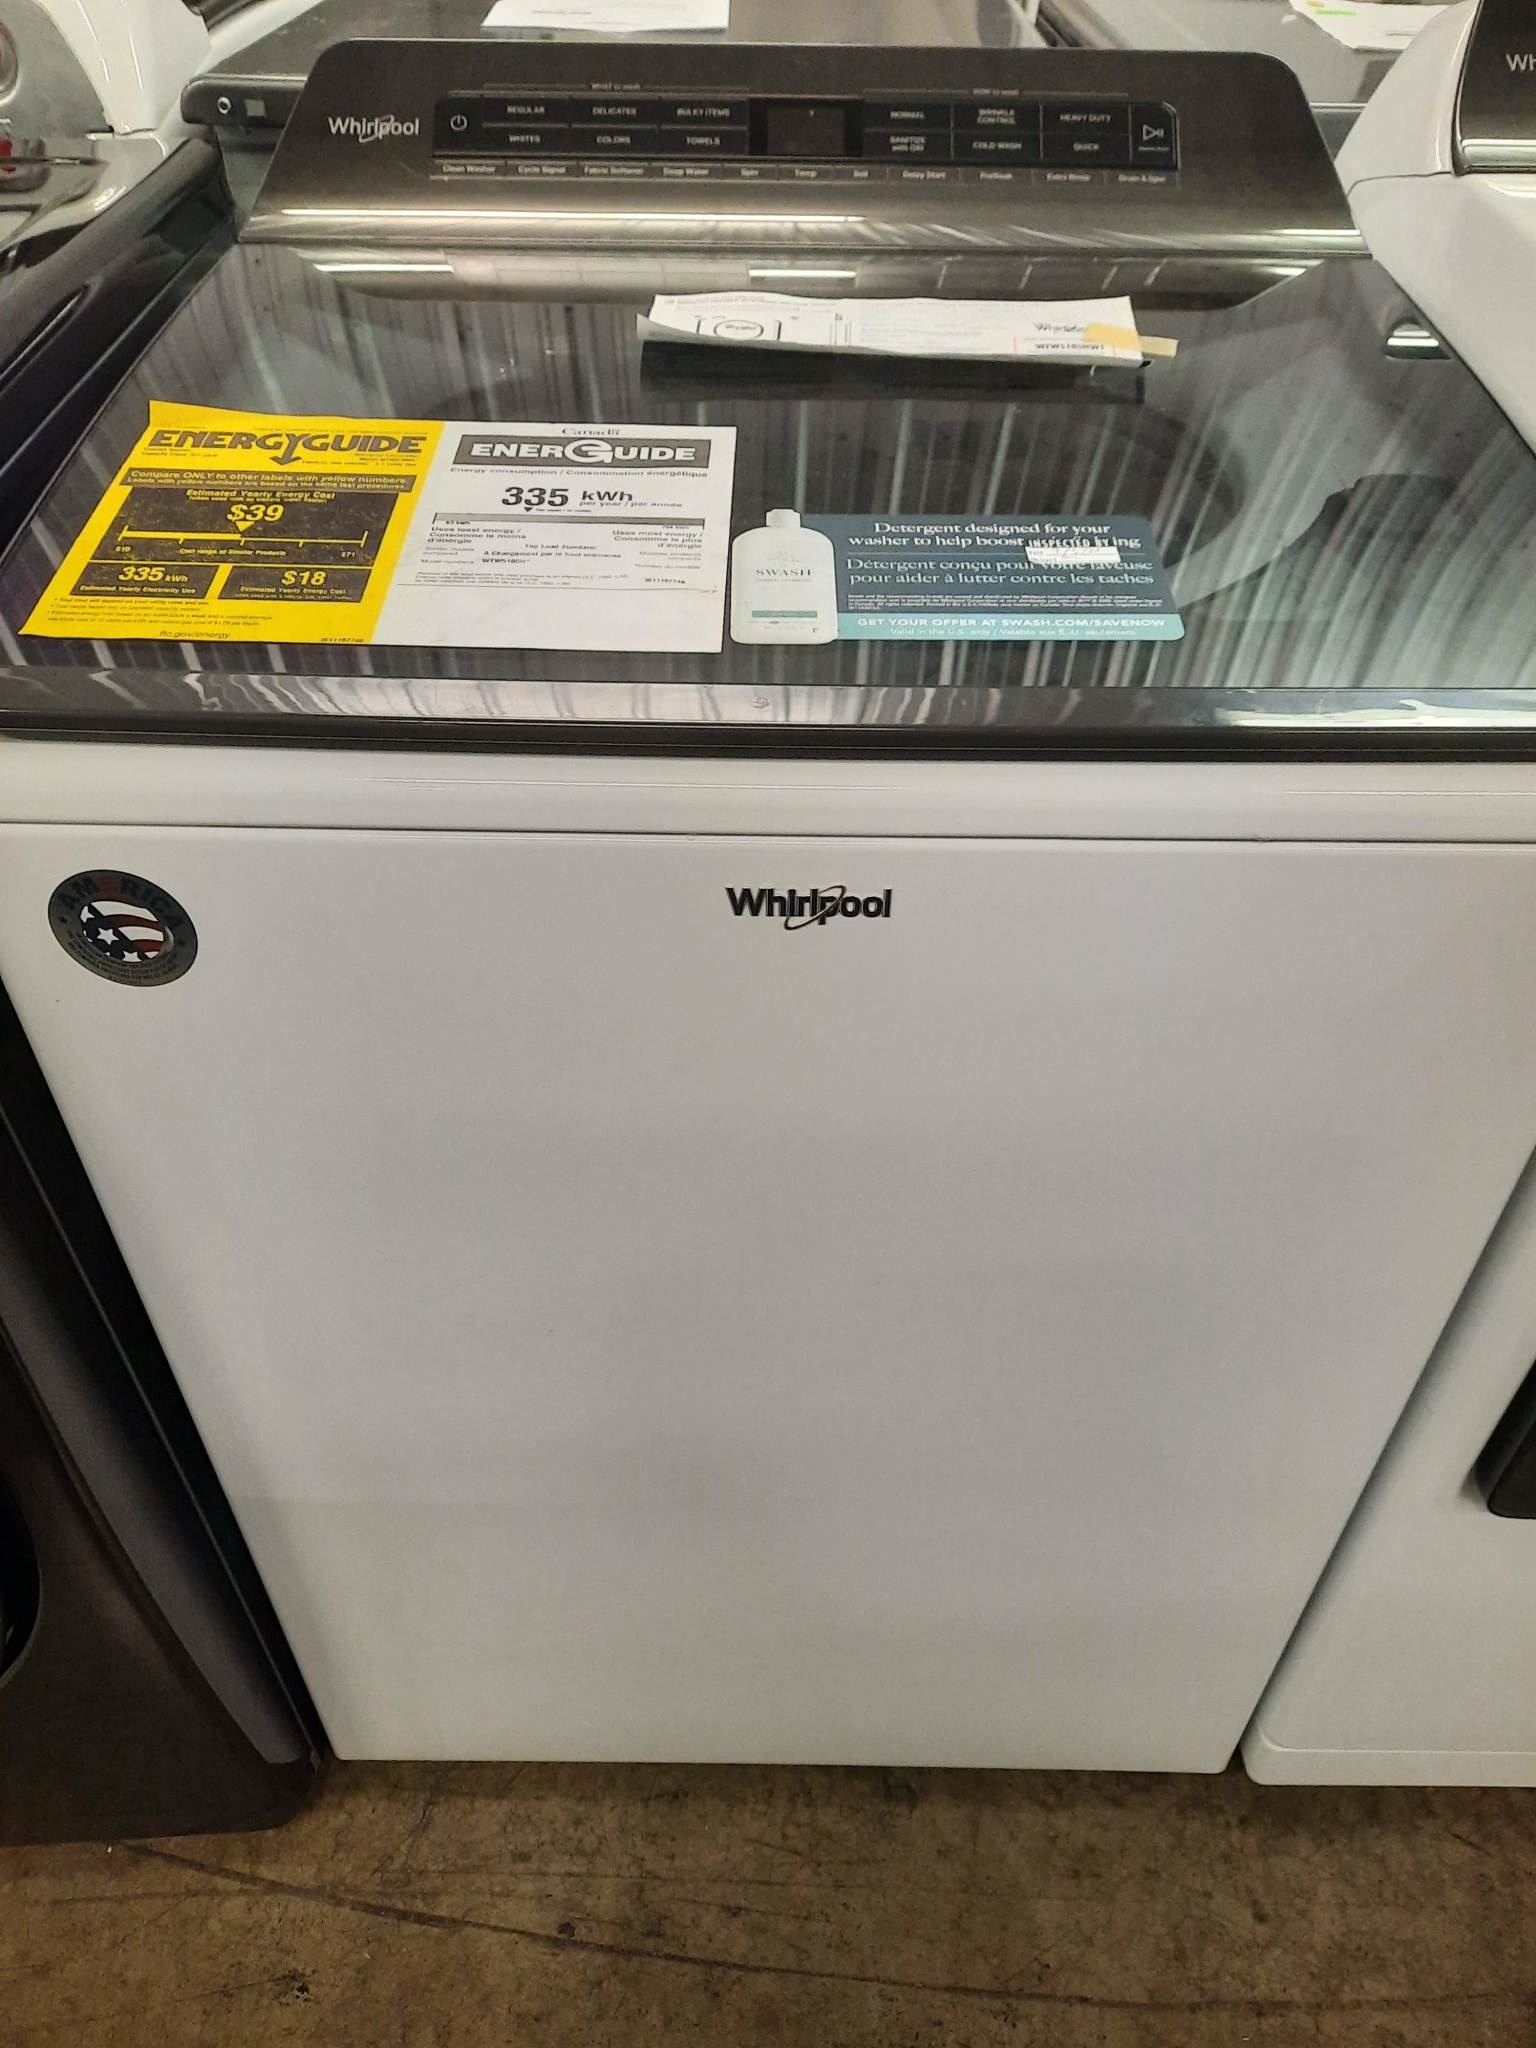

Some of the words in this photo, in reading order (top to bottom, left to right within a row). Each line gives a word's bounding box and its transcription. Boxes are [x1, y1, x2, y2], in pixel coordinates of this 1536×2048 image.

[507, 105, 546, 115] REGULAR
[592, 106, 638, 116] DELICATES
[890, 110, 926, 119] NORMAL
[1059, 113, 1089, 122] HEAVY
[1089, 113, 1112, 123] DUTY
[327, 115, 420, 143] Whirlpool
[509, 134, 541, 143] WHITES
[596, 135, 631, 145] COLORS
[686, 136, 721, 146] TOWELS
[972, 141, 998, 151] COLD
[998, 141, 1023, 150] WASH
[1072, 142, 1100, 151] QUICK
[740, 168, 760, 178] Spin
[795, 169, 818, 180] Temp
[149, 429, 428, 462] ENERGYGUIDE
[470, 438, 697, 465] ENERGUIDE
[131, 469, 181, 481] Compare
[183, 471, 215, 480] ONLY
[216, 472, 227, 480] to
[229, 472, 259, 481] other
[261, 473, 293, 482] labels
[321, 475, 354, 484] yellow
[450, 466, 487, 474] Energy
[488, 468, 559, 477] consumption
[566, 469, 645, 477] Consommation
[186, 489, 238, 498] Estimated
[240, 490, 273, 499] Yearly
[275, 491, 311, 500] Energy
[312, 492, 336, 500] Cost
[500, 486, 570, 507] 335
[581, 489, 634, 502] kWh
[596, 501, 618, 509] year
[226, 503, 285, 521] $39
[873, 521, 962, 536] Detergent
[964, 522, 1040, 537] designed
[1043, 522, 1069, 534] for
[1071, 525, 1112, 537] your
[848, 535, 911, 546] washer
[913, 536, 932, 546] to
[935, 535, 974, 549] help
[975, 537, 1026, 547] boost
[1028, 537, 1092, 548] INSPECTED
[1093, 536, 1110, 548] BY
[178, 547, 198, 556] Cost
[198, 548, 218, 557] range
[228, 549, 254, 557] Similar
[847, 557, 937, 572] Détergent
[939, 559, 992, 572] conçu
[996, 560, 1036, 572] pour
[118, 565, 166, 582] 335
[165, 573, 188, 583] kWh
[754, 567, 813, 577] SWASH
[280, 570, 327, 587] $18
[849, 573, 892, 586] pour
[894, 572, 942, 584] aider
[943, 572, 955, 584] à
[957, 572, 1008, 584] lutter
[1009, 574, 1067, 584] contre
[1069, 573, 1096, 584] les
[1097, 573, 1156, 585] taches
[79, 585, 117, 593] Estimated
[142, 586, 180, 595] Electricity
[857, 617, 885, 627] GET
[887, 618, 929, 627] YOUR
[930, 618, 978, 627] OFFER
[980, 619, 997, 627] AT
[1000, 618, 1166, 628] SWASH.COM/SAVENOW
[55, 873, 185, 929] AMERICA
[724, 886, 893, 929] Whirlpool
